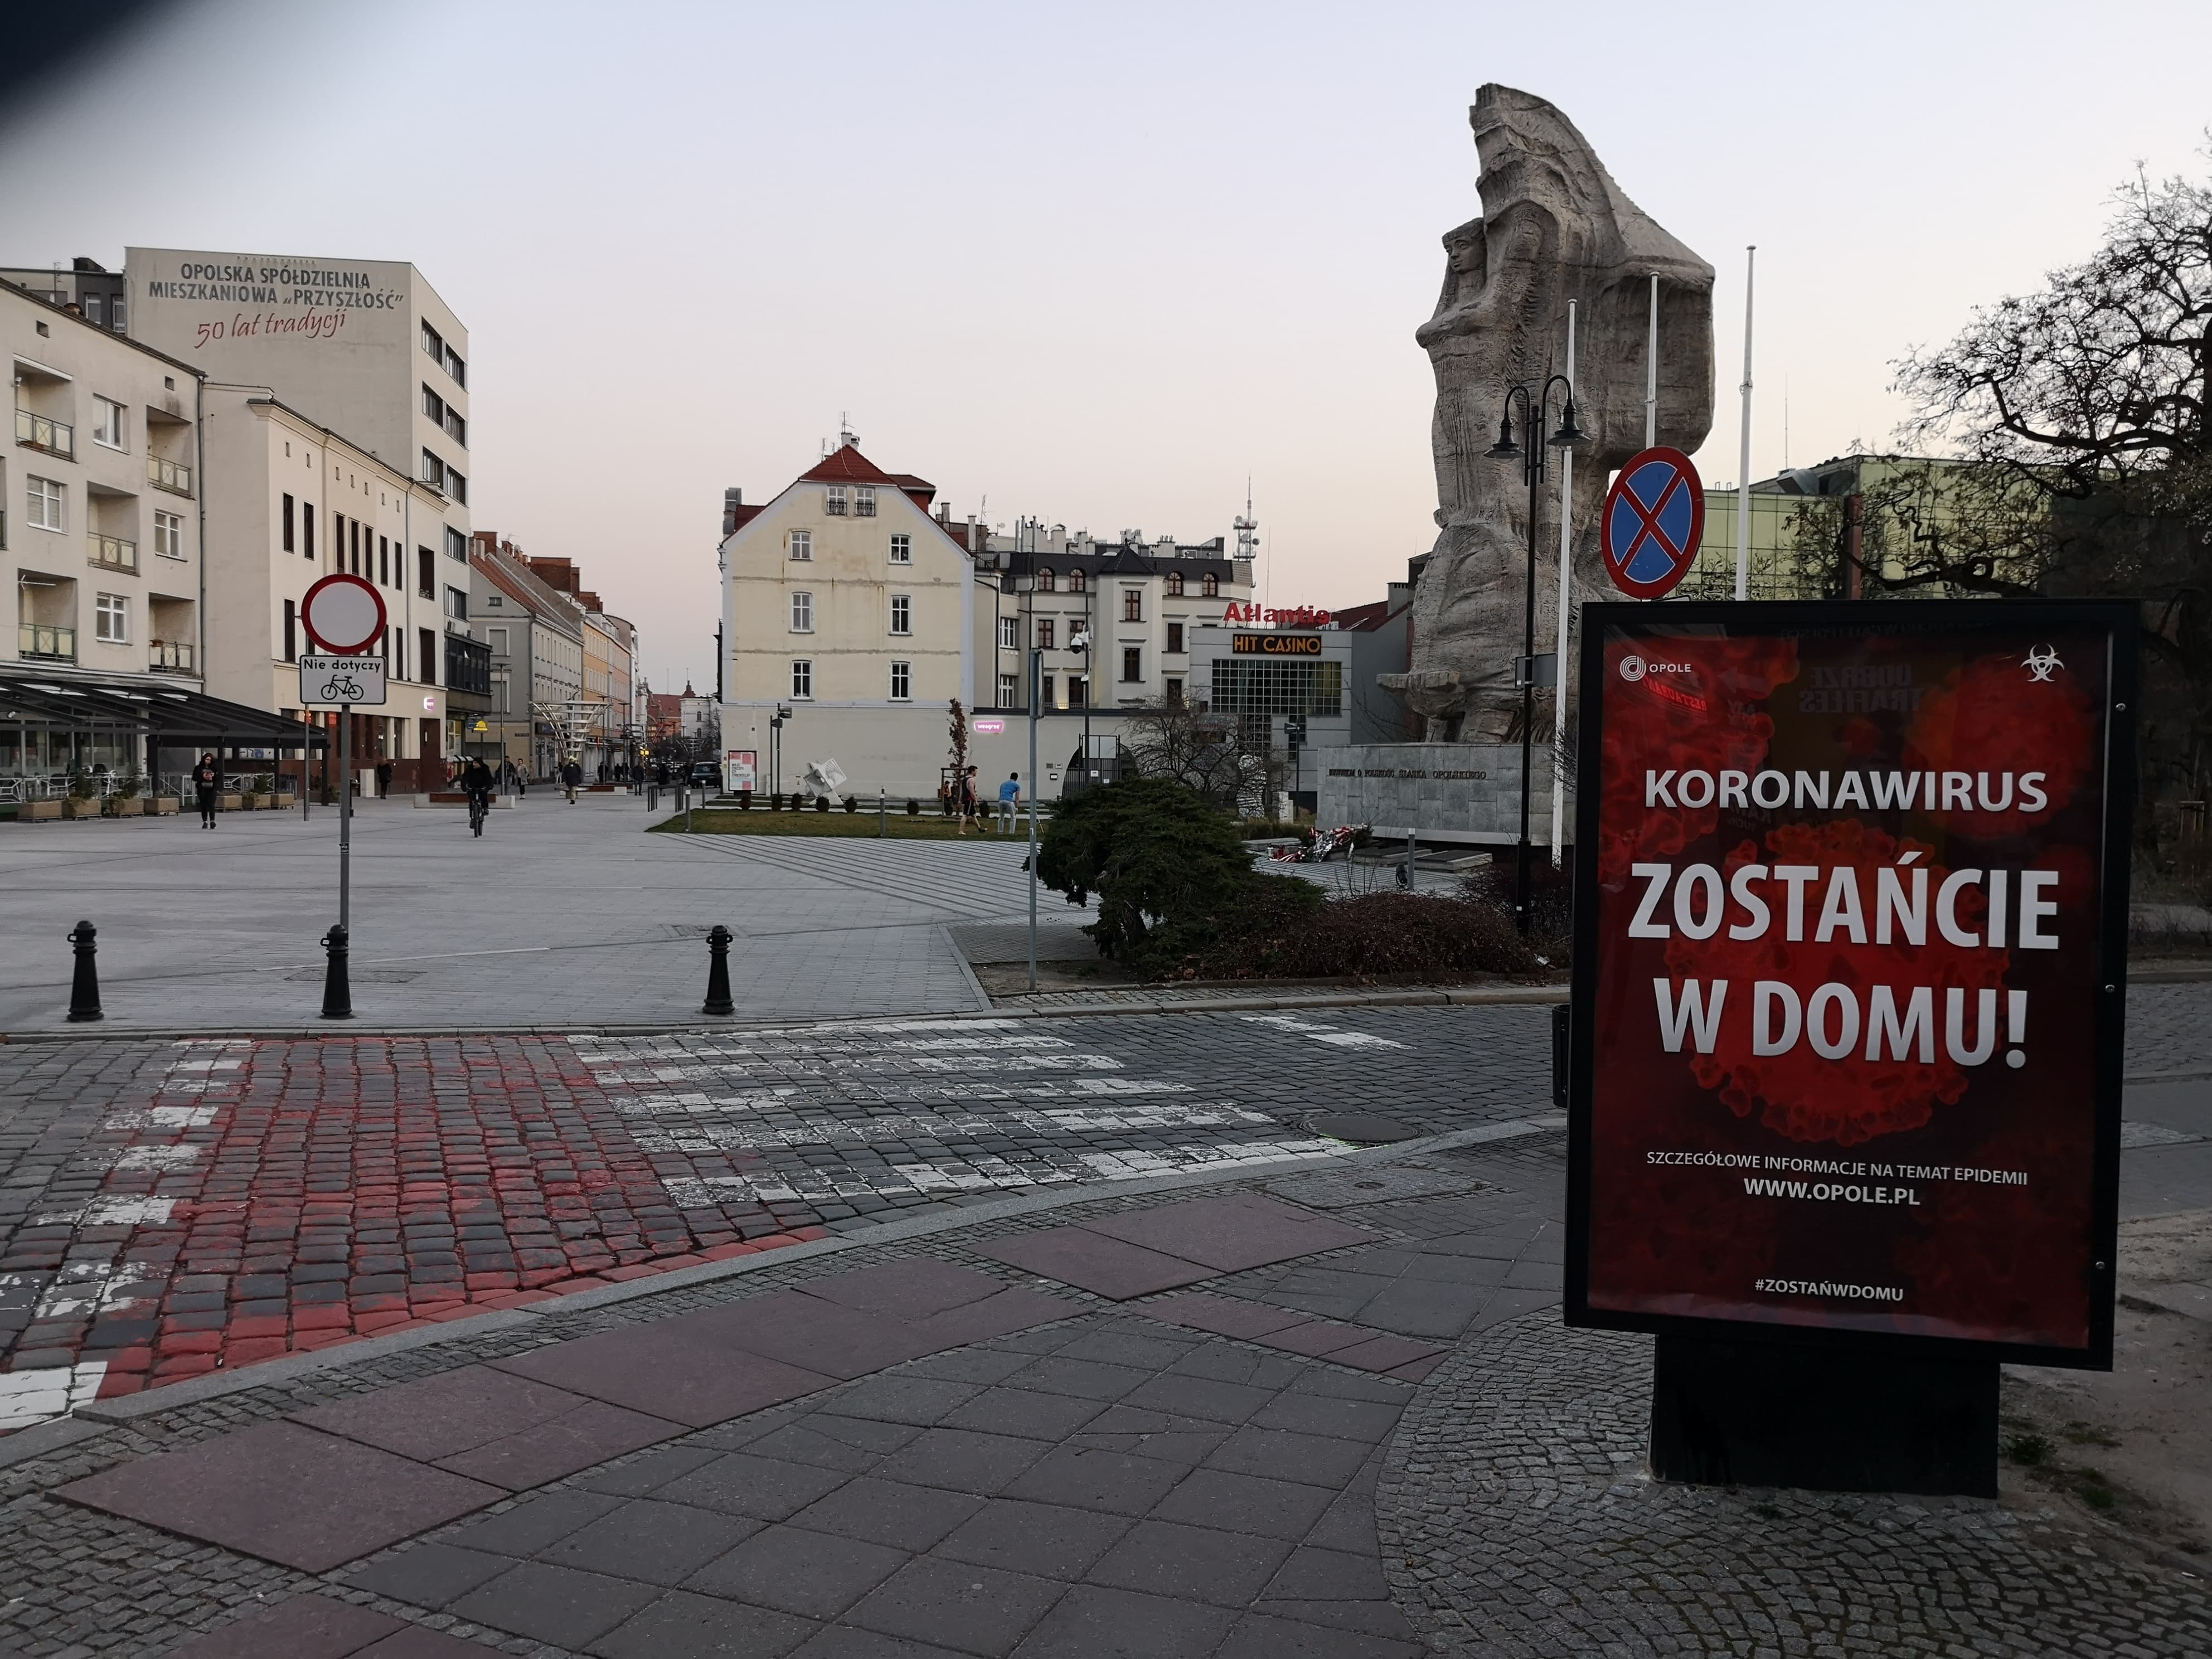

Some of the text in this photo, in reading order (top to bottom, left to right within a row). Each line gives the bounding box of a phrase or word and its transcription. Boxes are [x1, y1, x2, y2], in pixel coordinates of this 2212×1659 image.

[181, 263, 370, 289] OPOLSKA SPÓŁDZIELNIA
[149, 282, 278, 304] MIESZKANIOWA
[194, 307, 347, 349] 50 lat tradycji
[1224, 601, 1332, 624] Atlantis
[1234, 636, 1321, 653] HIT CASINO
[304, 659, 380, 673] Nie dotyczy
[1650, 663, 1691, 673] OPOLE
[1433, 770, 1487, 780] OPOLSKIEGO
[1645, 769, 2048, 813] KORONAWIRUS
[1628, 851, 2059, 950] ZOSTAŃCIE
[1653, 978, 2028, 1069] W DOMU!
[1647, 1151, 2027, 1185] SZCZEGÓŁOWE INFORMACJE NA TEMAT EPIDEMII
[1744, 1178, 1920, 1205] WWW.OPOLE.PL
[1755, 1279, 1904, 1302] #ZOSTAŃWDOMU
